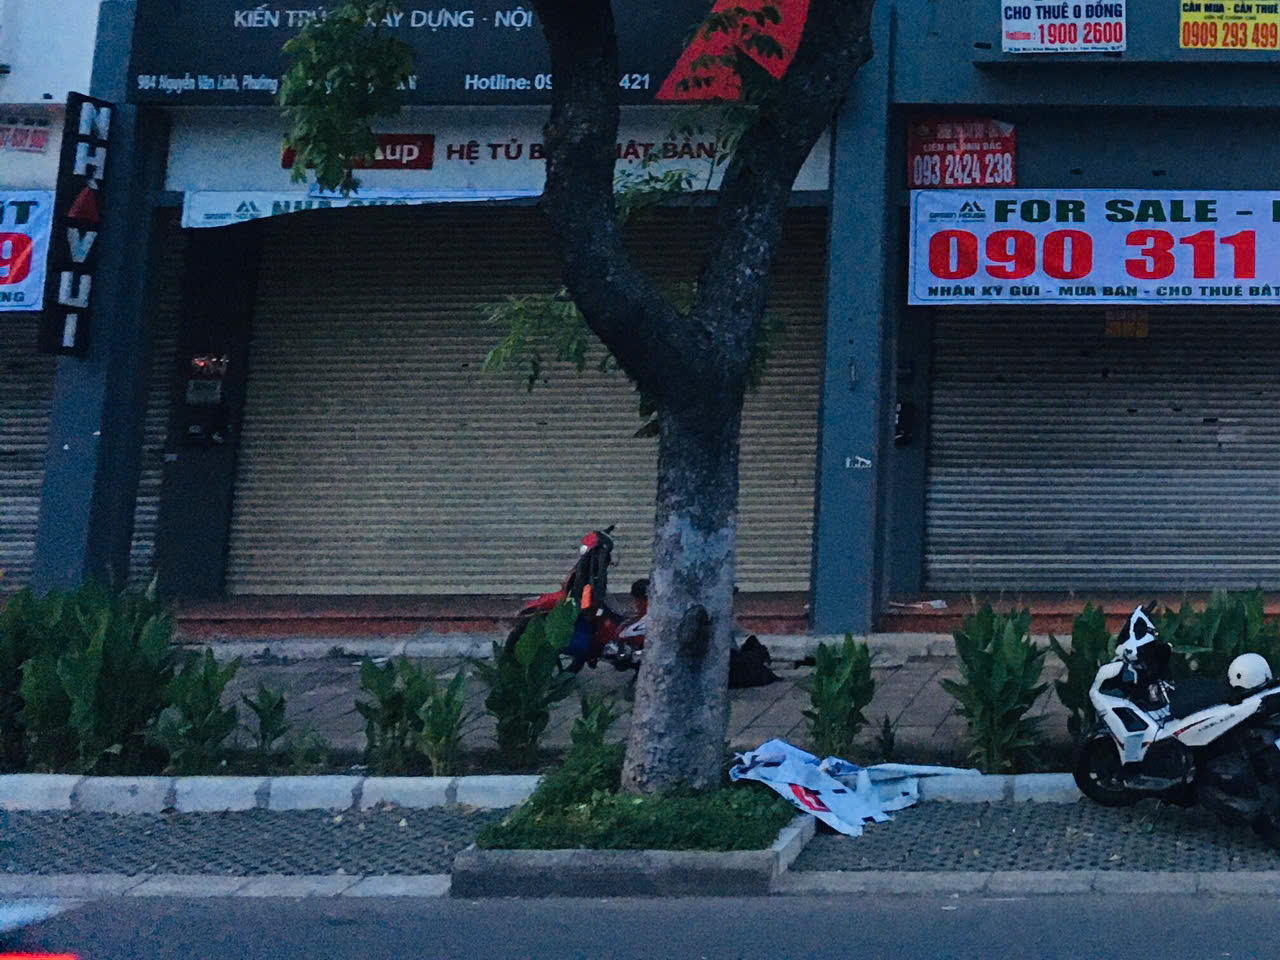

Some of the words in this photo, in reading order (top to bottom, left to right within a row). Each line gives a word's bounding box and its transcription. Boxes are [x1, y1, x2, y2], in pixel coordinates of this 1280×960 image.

[233, 3, 280, 28] KIẾN
[411, 8, 474, 31] DỰNG
[494, 6, 533, 31] NỘI
[1004, 6, 1031, 20] CHO
[1035, 1, 1069, 20] THUÊ
[1038, 23, 1078, 44] 1900
[1083, 22, 1123, 44] 2600
[1182, 21, 1217, 47] 0909
[1222, 22, 1248, 47] 293
[1251, 22, 1278, 47] 499
[465, 74, 530, 90] Hotline:
[447, 140, 480, 165] HỆ
[488, 137, 522, 160] TỦ
[914, 154, 940, 185] 093
[945, 153, 981, 185] 2424
[985, 152, 1013, 184] 238
[994, 199, 1085, 222] FOR
[1105, 199, 1218, 222] SALE
[928, 229, 1093, 280] 090
[1125, 229, 1256, 280] 311
[1059, 285, 1096, 297] MUA
[1156, 285, 1192, 297] CHO
